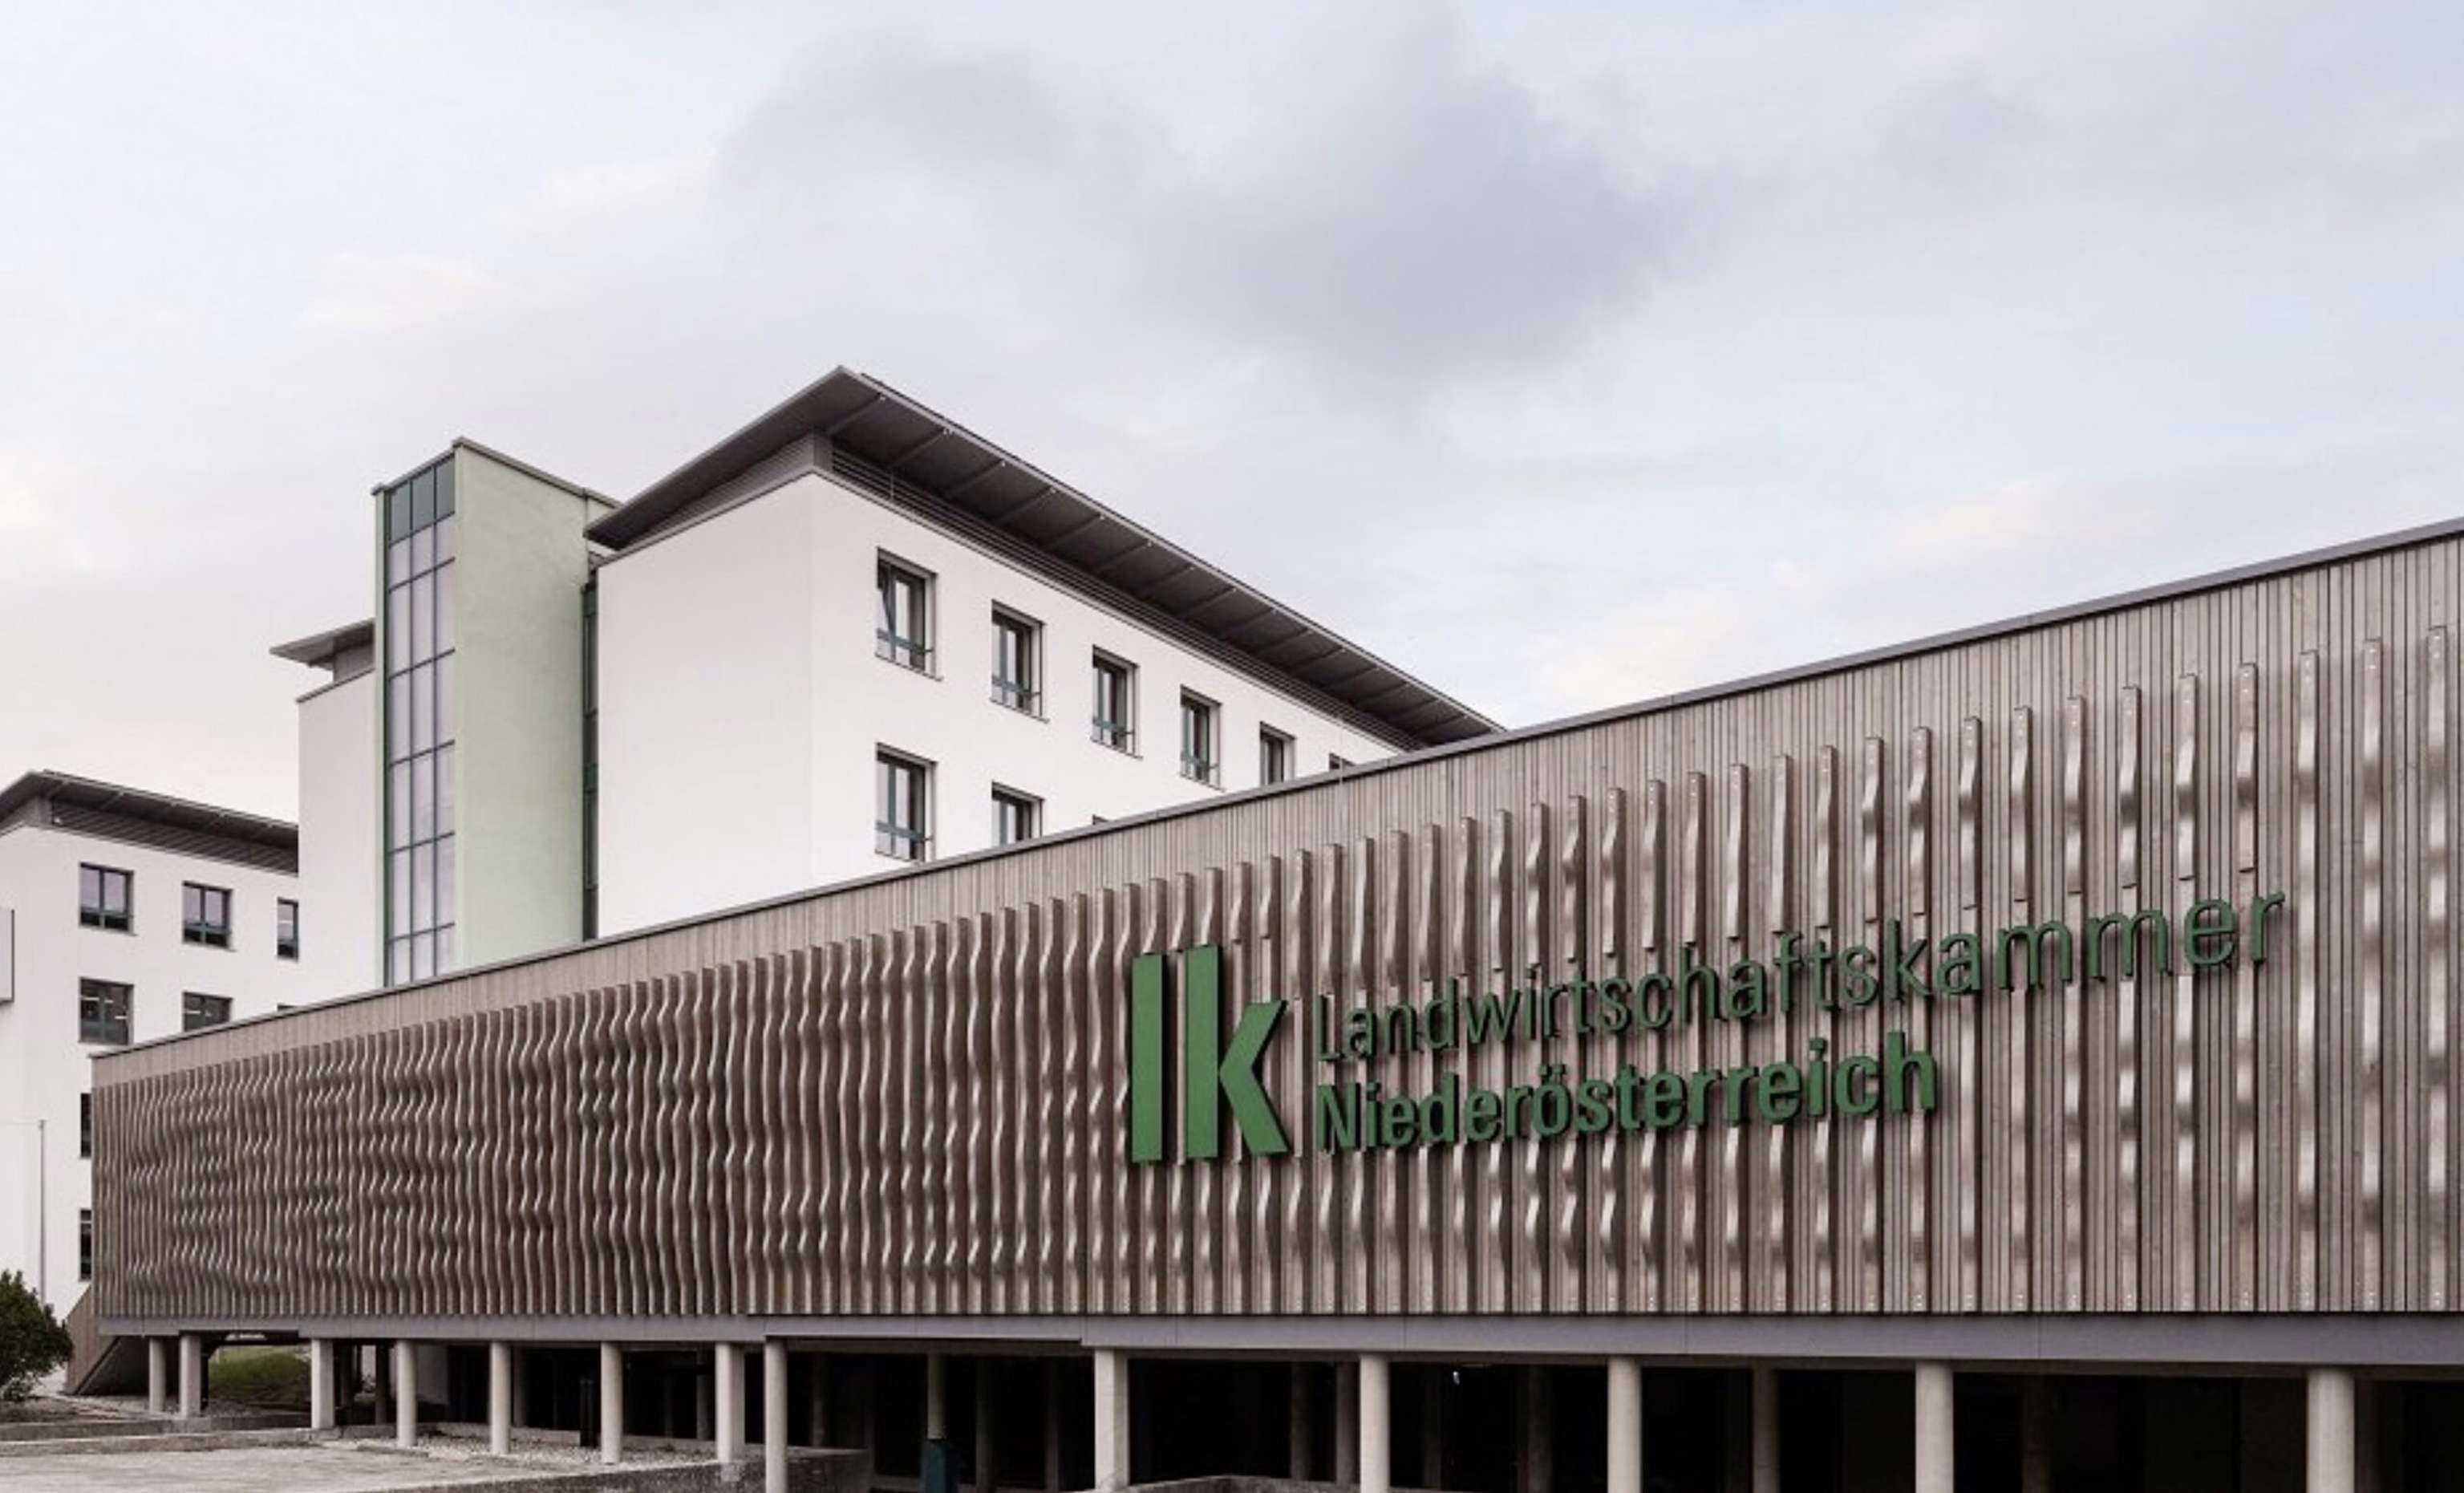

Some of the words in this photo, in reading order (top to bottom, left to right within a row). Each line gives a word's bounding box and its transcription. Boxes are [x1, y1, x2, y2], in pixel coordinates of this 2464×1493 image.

[1132, 944, 1289, 1164] lk
[1317, 891, 2284, 1061] Landwirtschaftskammer
[1316, 1030, 1938, 1154] Niederösterreich
